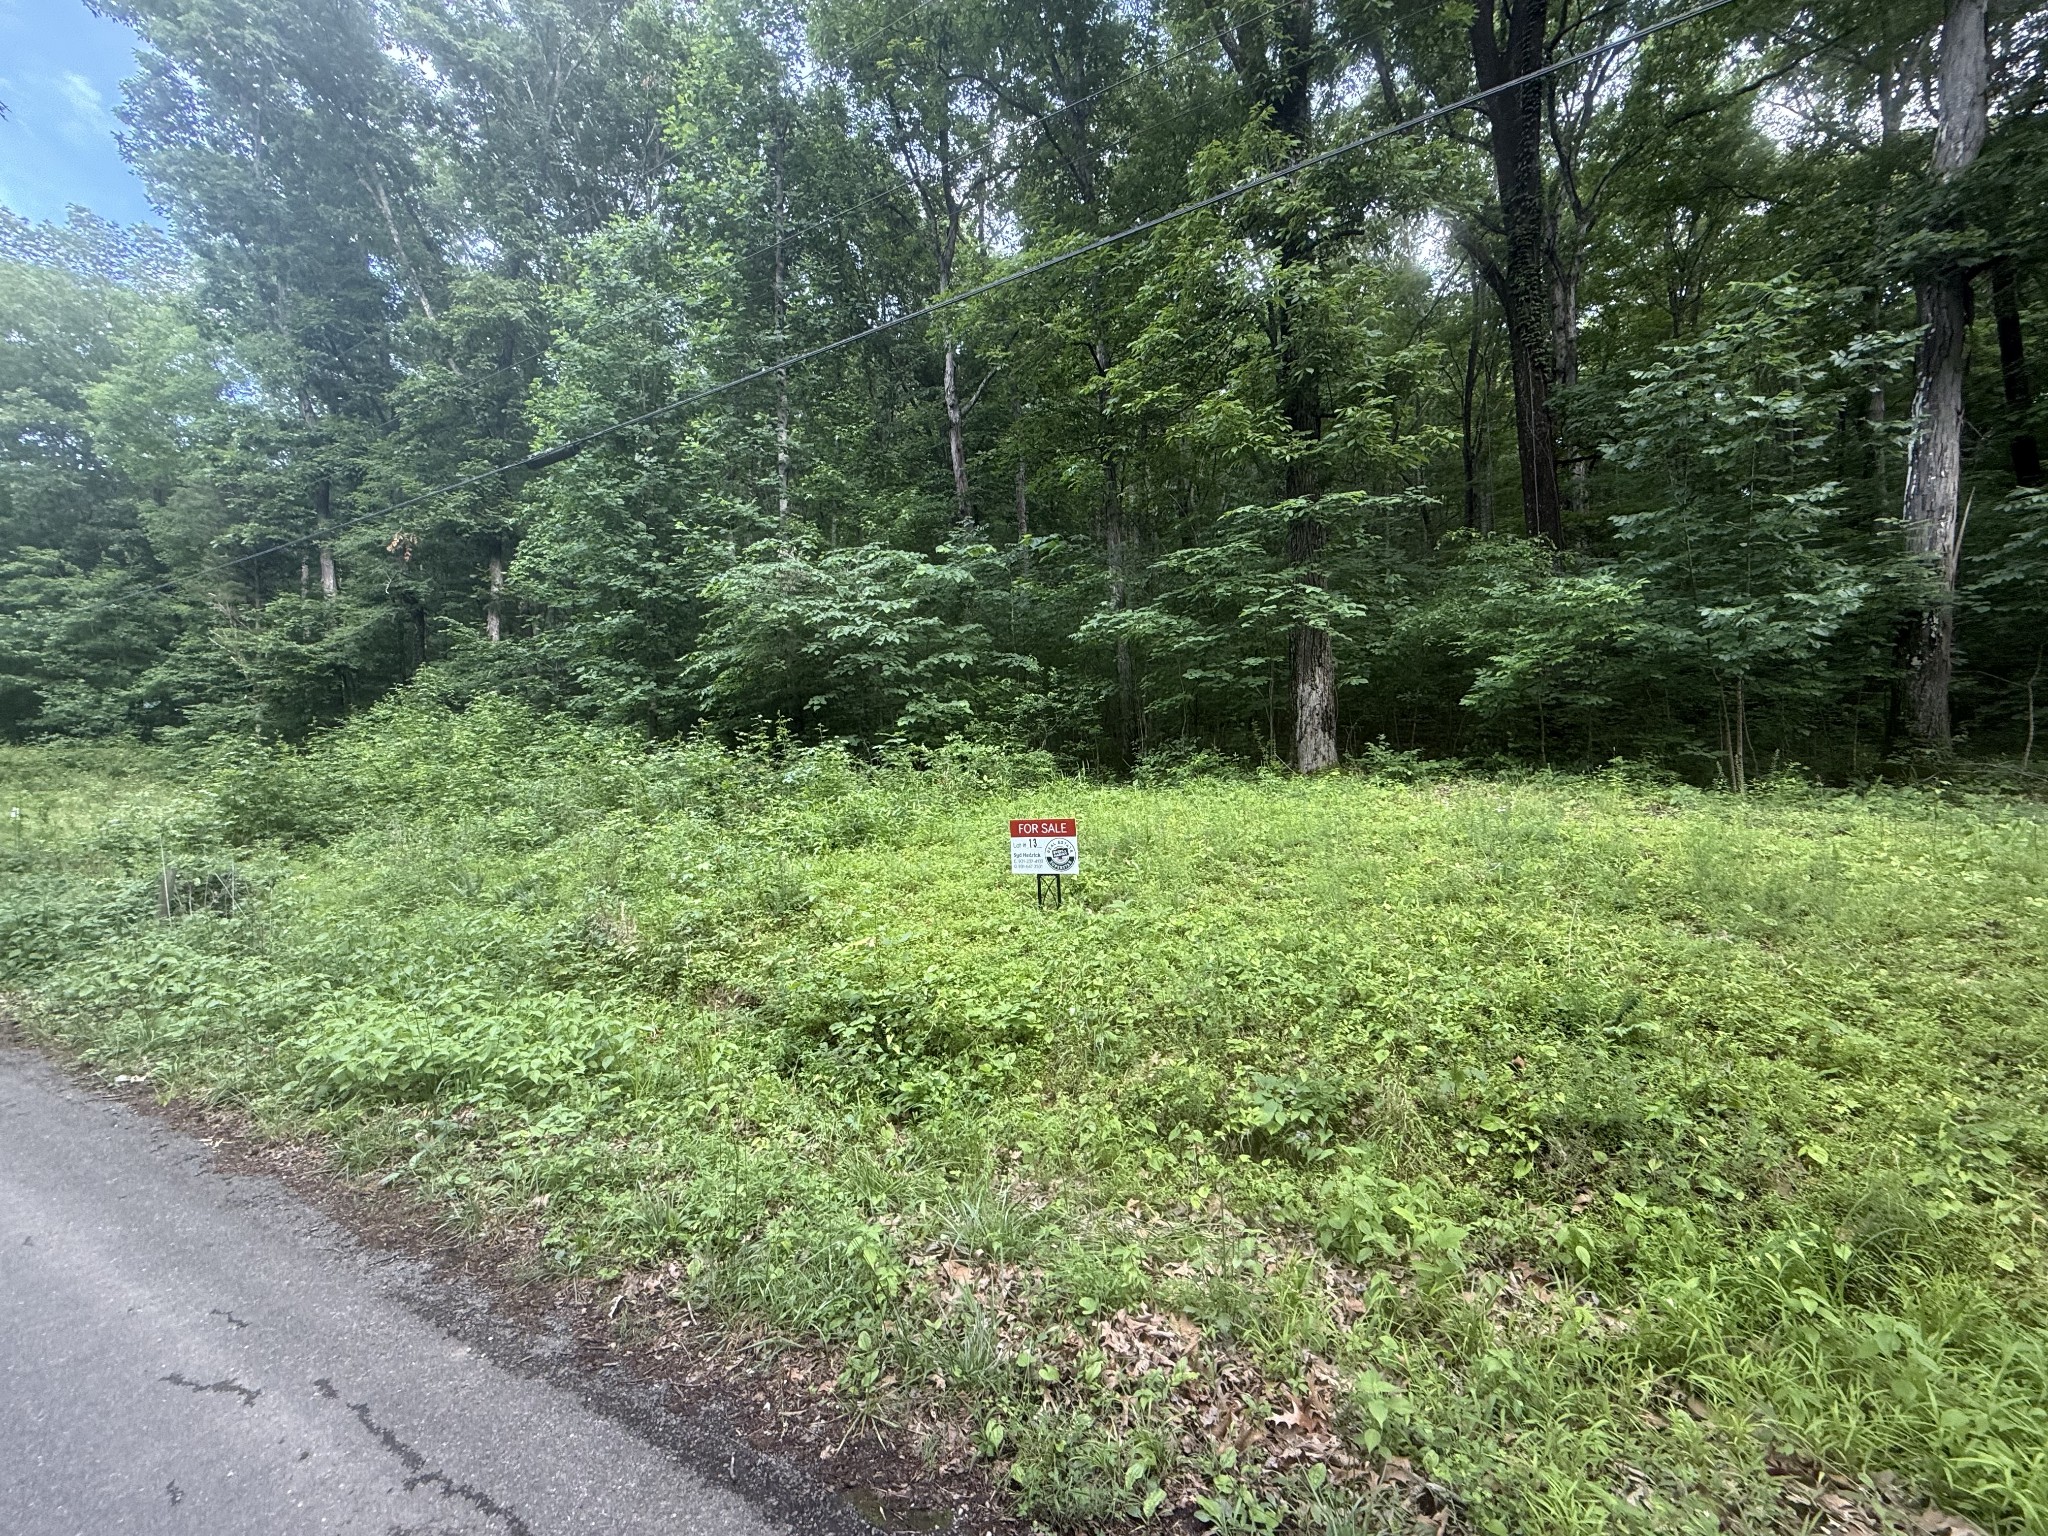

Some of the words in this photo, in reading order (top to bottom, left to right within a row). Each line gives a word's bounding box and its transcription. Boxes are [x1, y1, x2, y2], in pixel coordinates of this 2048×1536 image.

[1018, 823, 1038, 834] FOR
[1041, 823, 1067, 834] SALE
[1028, 838, 1038, 848] 13
